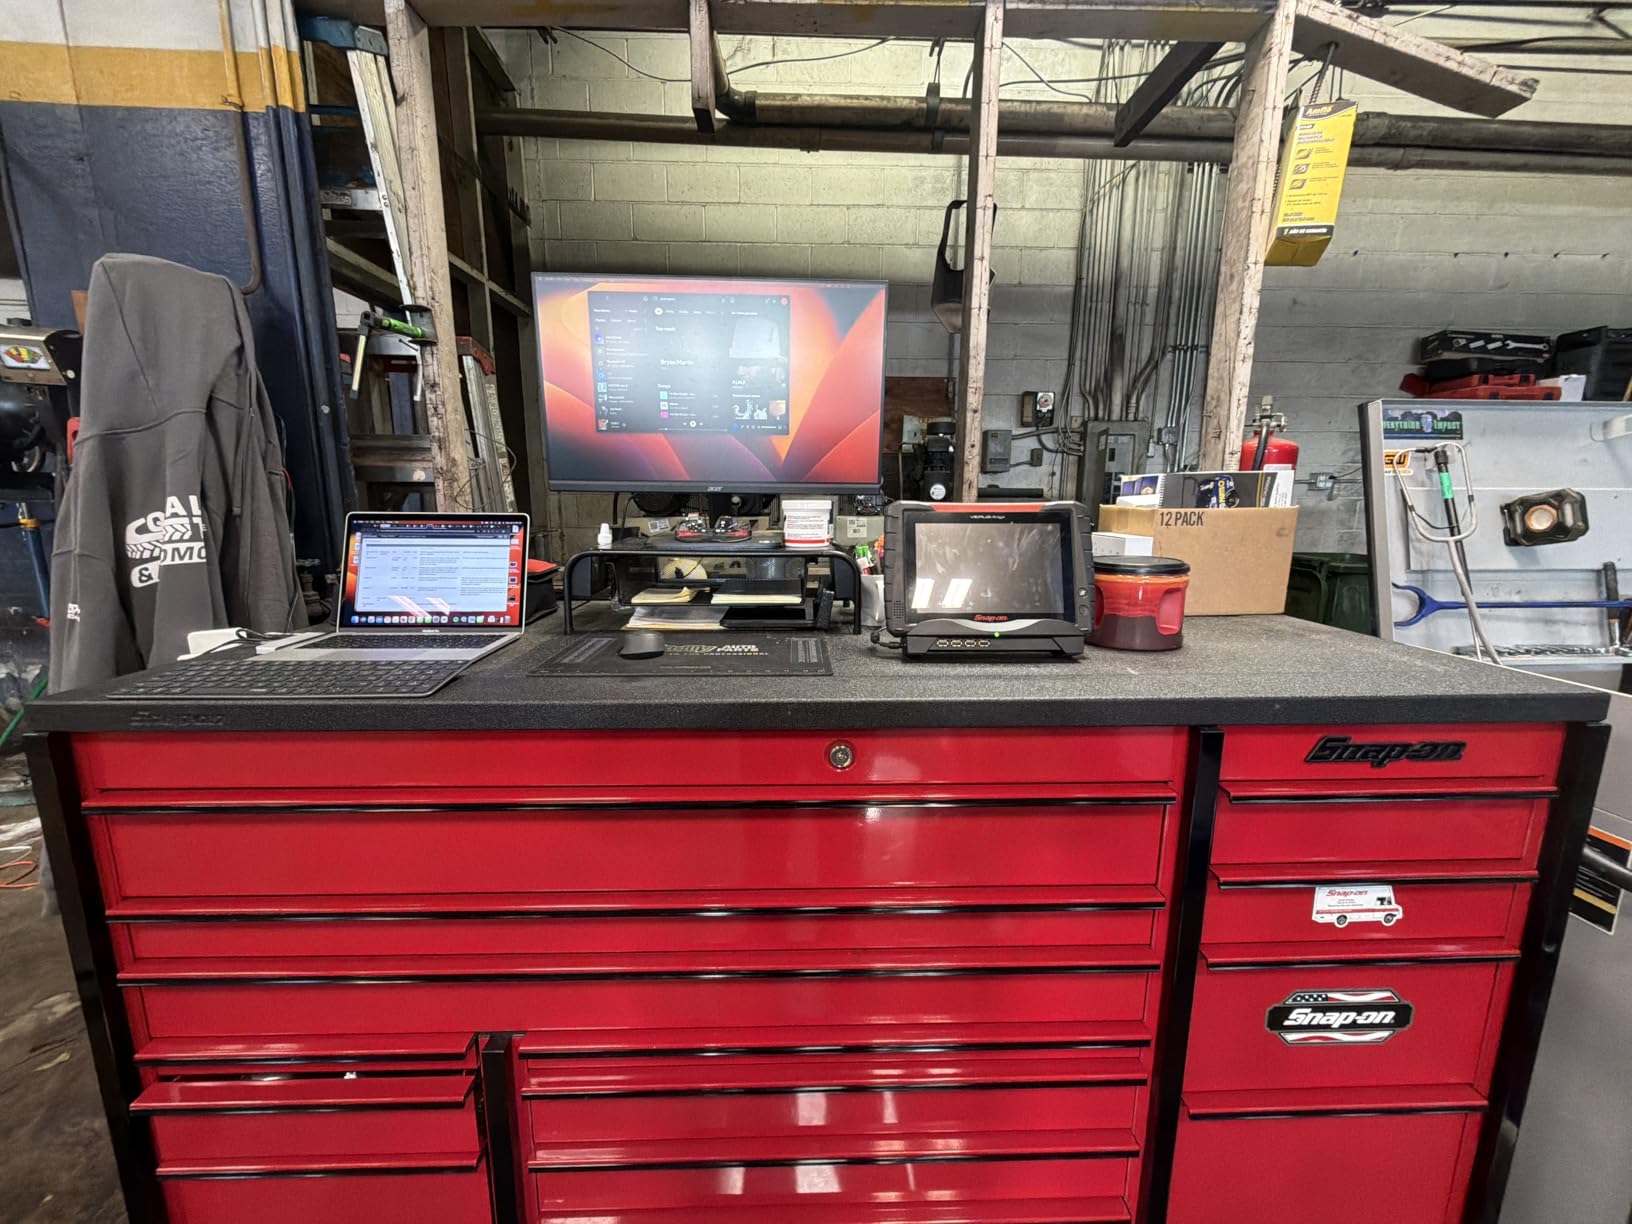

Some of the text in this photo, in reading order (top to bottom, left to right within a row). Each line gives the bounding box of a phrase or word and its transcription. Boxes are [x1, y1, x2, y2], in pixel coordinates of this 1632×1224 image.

[1159, 511, 1205, 527] 12 PACK
[974, 614, 1009, 622] Snap-on
[1304, 735, 1467, 768] Snap-on
[1326, 889, 1369, 897] Snap-on
[1282, 1008, 1396, 1028] Snap-on
